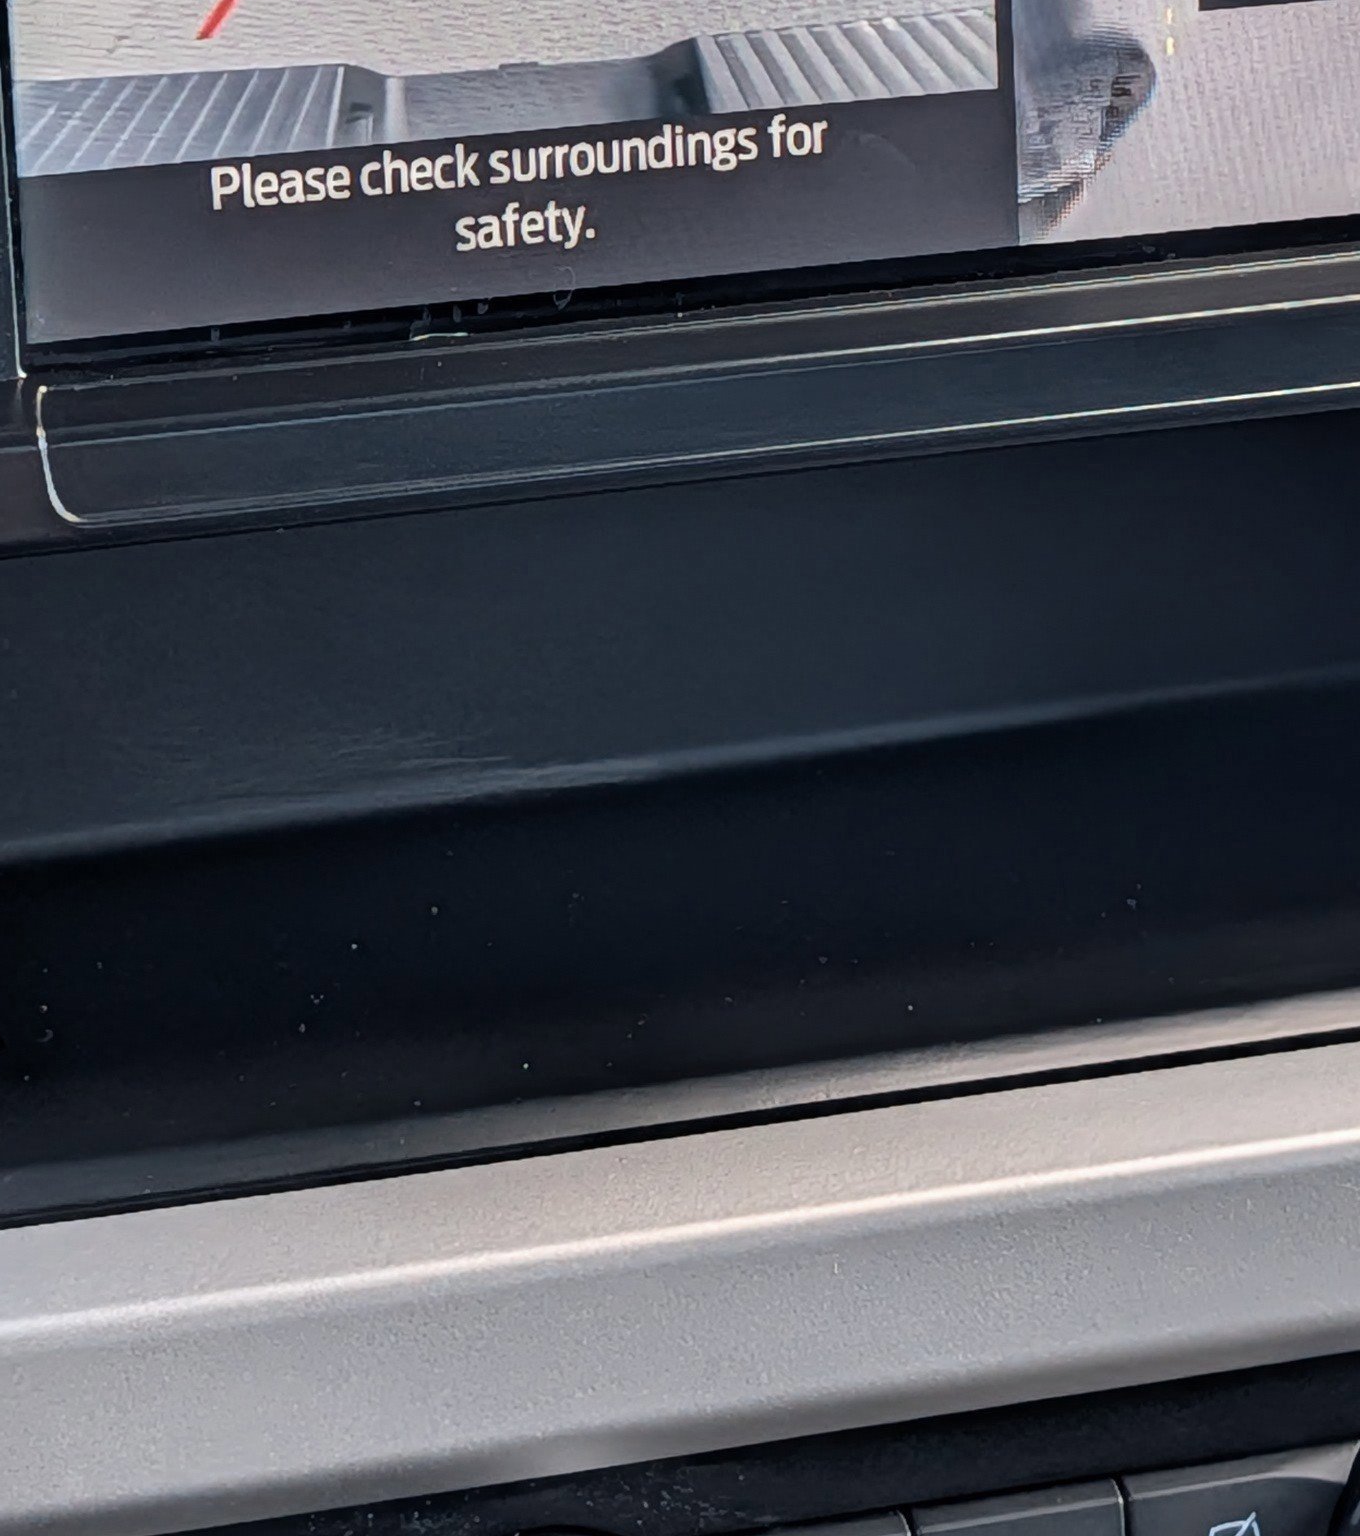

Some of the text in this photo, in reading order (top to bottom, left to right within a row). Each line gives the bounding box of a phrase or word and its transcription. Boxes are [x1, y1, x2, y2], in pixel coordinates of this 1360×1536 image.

[211, 113, 828, 210] Please check surroundings for
[455, 200, 597, 251] safety.
